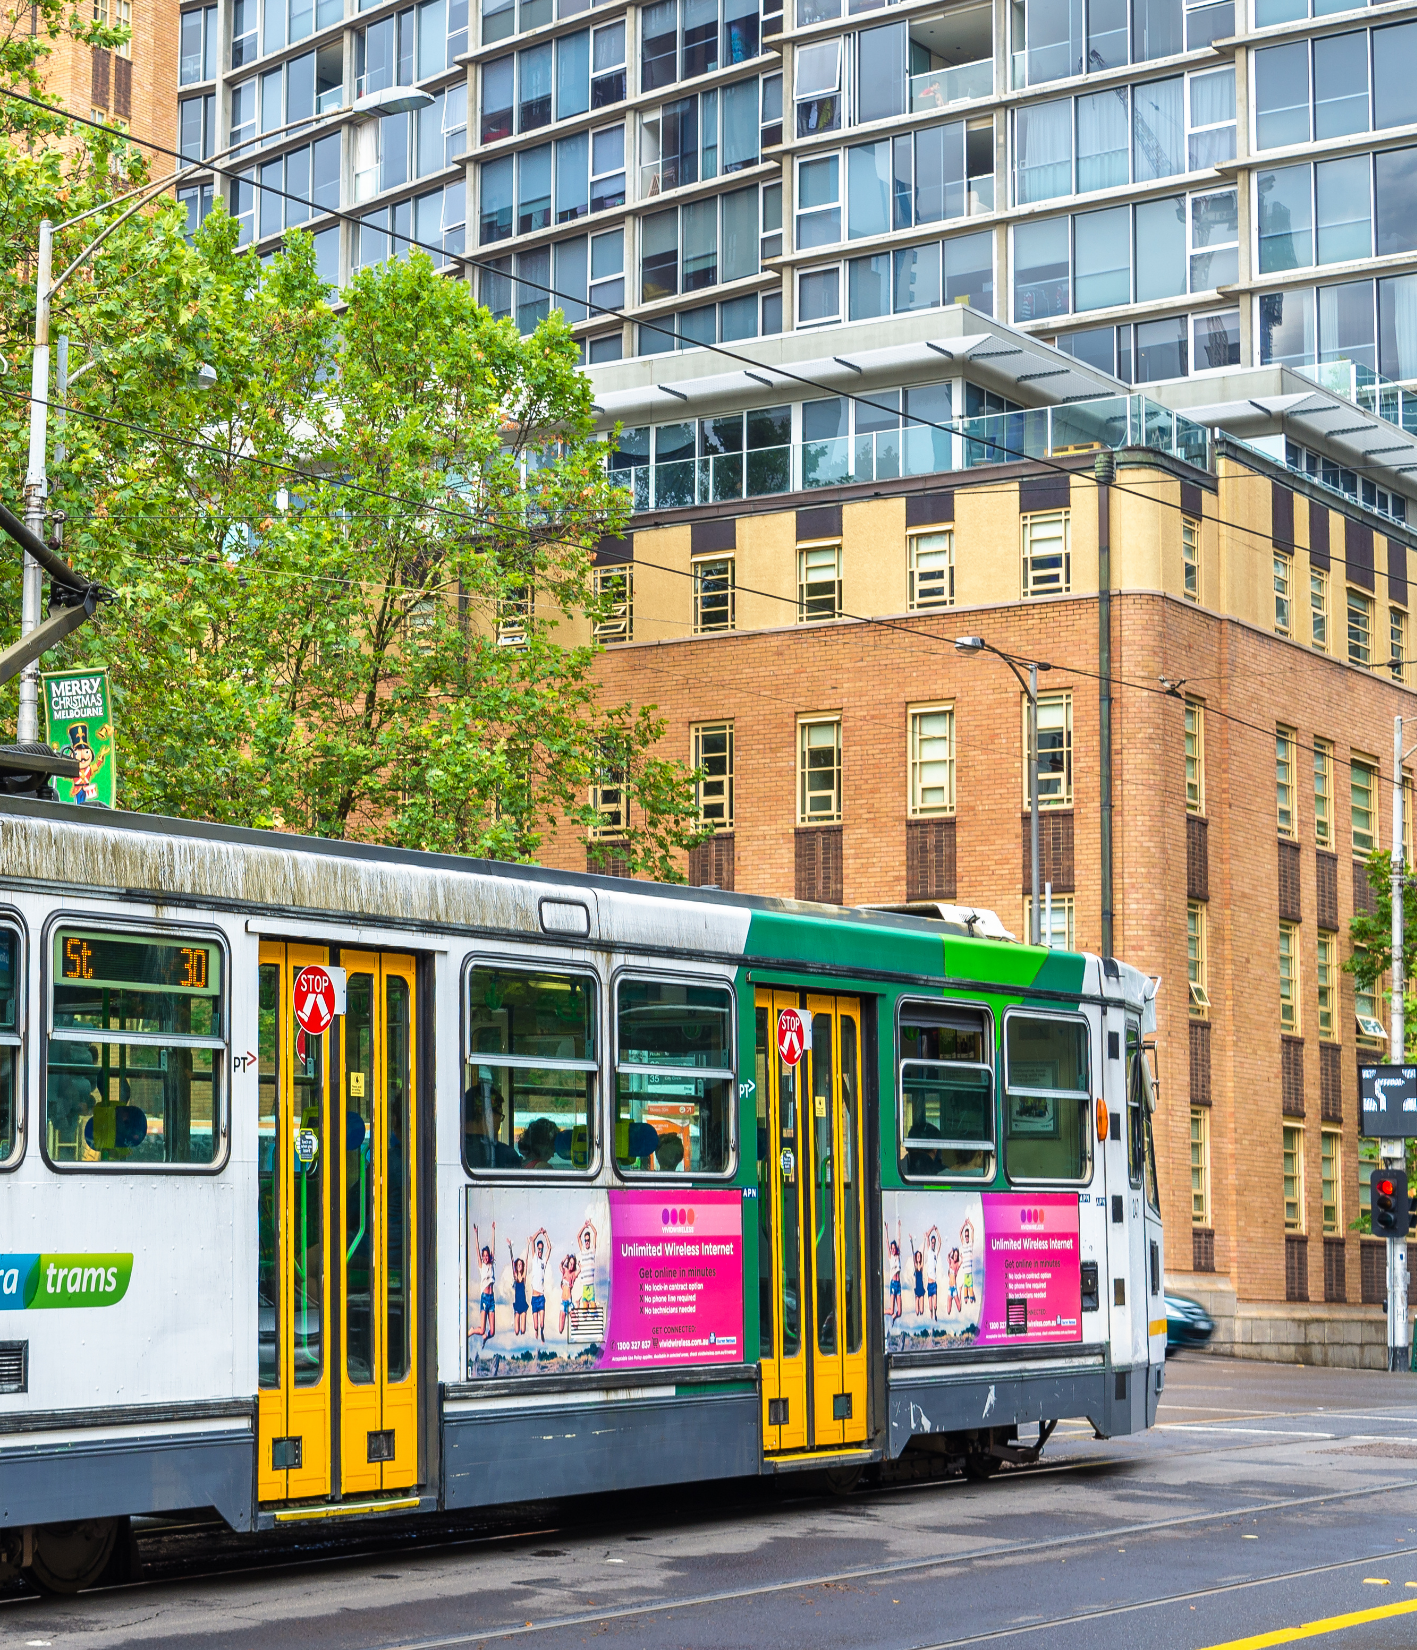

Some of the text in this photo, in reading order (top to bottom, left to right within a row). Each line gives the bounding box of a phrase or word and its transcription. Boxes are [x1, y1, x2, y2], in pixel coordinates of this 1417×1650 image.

[51, 678, 101, 697] MERRY
[52, 693, 102, 710] CHRISTMAS
[54, 707, 103, 719] MELBOURNE
[66, 938, 207, 988] St 30
[300, 974, 329, 993] STOP
[781, 1016, 800, 1031] STOP
[234, 1056, 248, 1073] PT
[649, 1074, 660, 1083] 35
[739, 1084, 749, 1098] PT
[743, 1188, 757, 1198] APN
[662, 1226, 694, 1234] VIVIDWIRELESS
[621, 1242, 734, 1257] Unlimited Wireless Internet
[991, 1237, 1073, 1251] Unlimited Wireless Internet
[1004, 1259, 1061, 1269] Get online in minutes
[46, 1263, 118, 1294] trams
[639, 1266, 716, 1279] Get online in minutes
[644, 1282, 704, 1291] No lock-in contract option
[644, 1293, 696, 1303] No phone line required
[644, 1305, 696, 1315] No technicians needed
[652, 1325, 697, 1334] GET CONNECTED:
[616, 1340, 651, 1350] 1300 327 837
[659, 1338, 709, 1348] vividwireless.com.au
